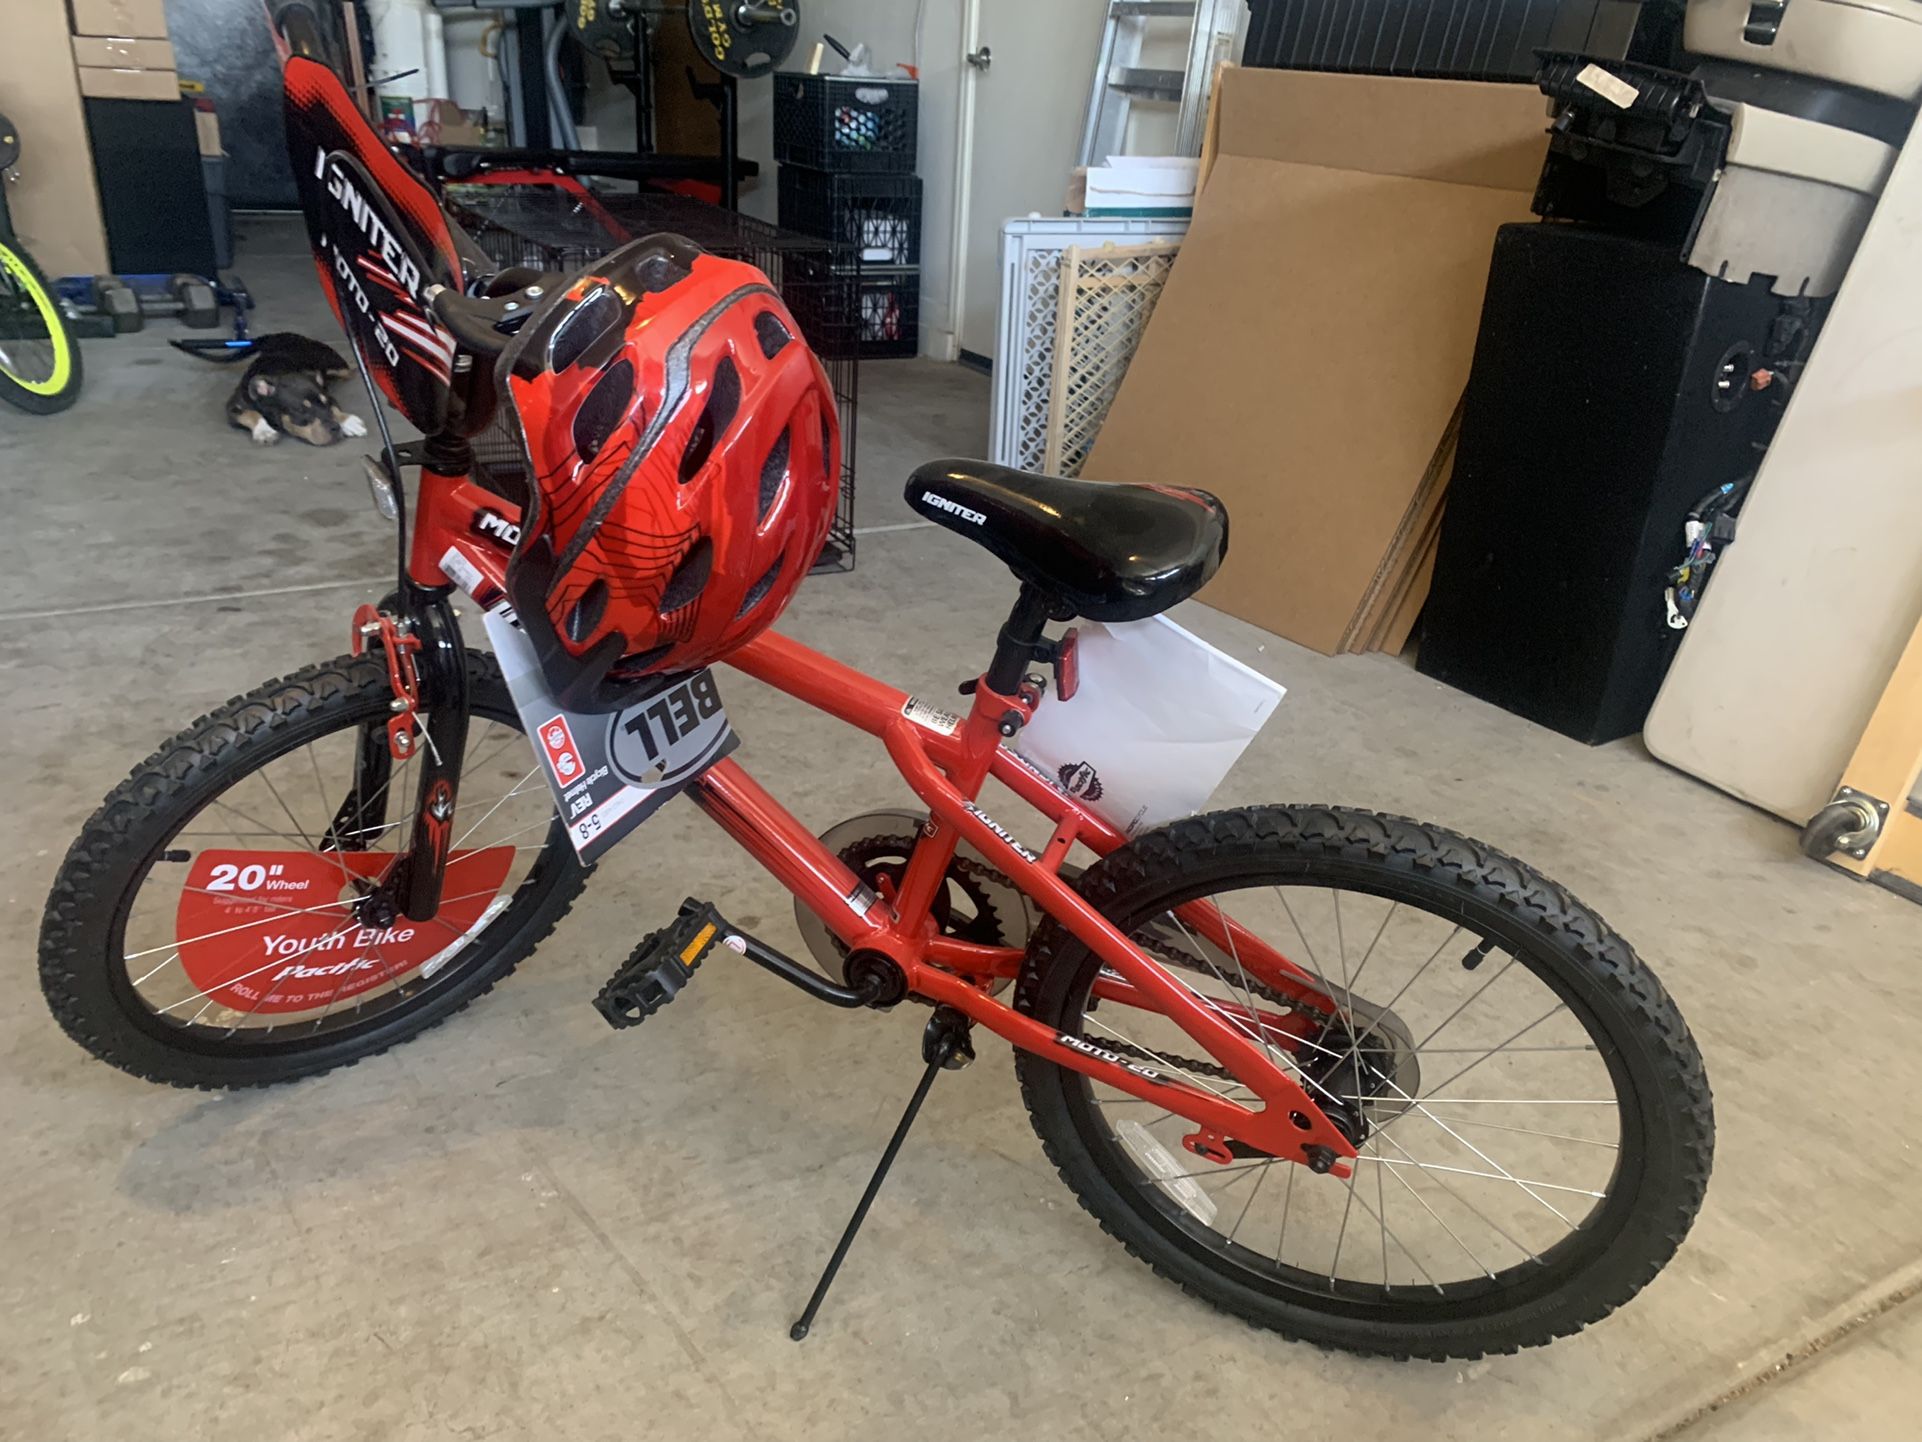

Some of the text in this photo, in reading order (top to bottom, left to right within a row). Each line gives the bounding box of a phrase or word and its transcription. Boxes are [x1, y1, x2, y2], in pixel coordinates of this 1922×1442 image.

[314, 146, 420, 299] IGNITER
[922, 491, 987, 526] IGNITER
[624, 668, 723, 761] BELL
[570, 792, 593, 819] REV
[579, 814, 602, 839] 5-8
[974, 810, 1037, 862] IGNITER
[206, 864, 310, 891] 20" Wheel
[263, 927, 415, 956] Youth Bike
[271, 957, 380, 982] Pacific
[230, 983, 260, 1001] ROLL
[286, 995, 303, 1003] TO
[308, 989, 334, 1001] THE
[1061, 1035, 1159, 1079] MOTO-20
